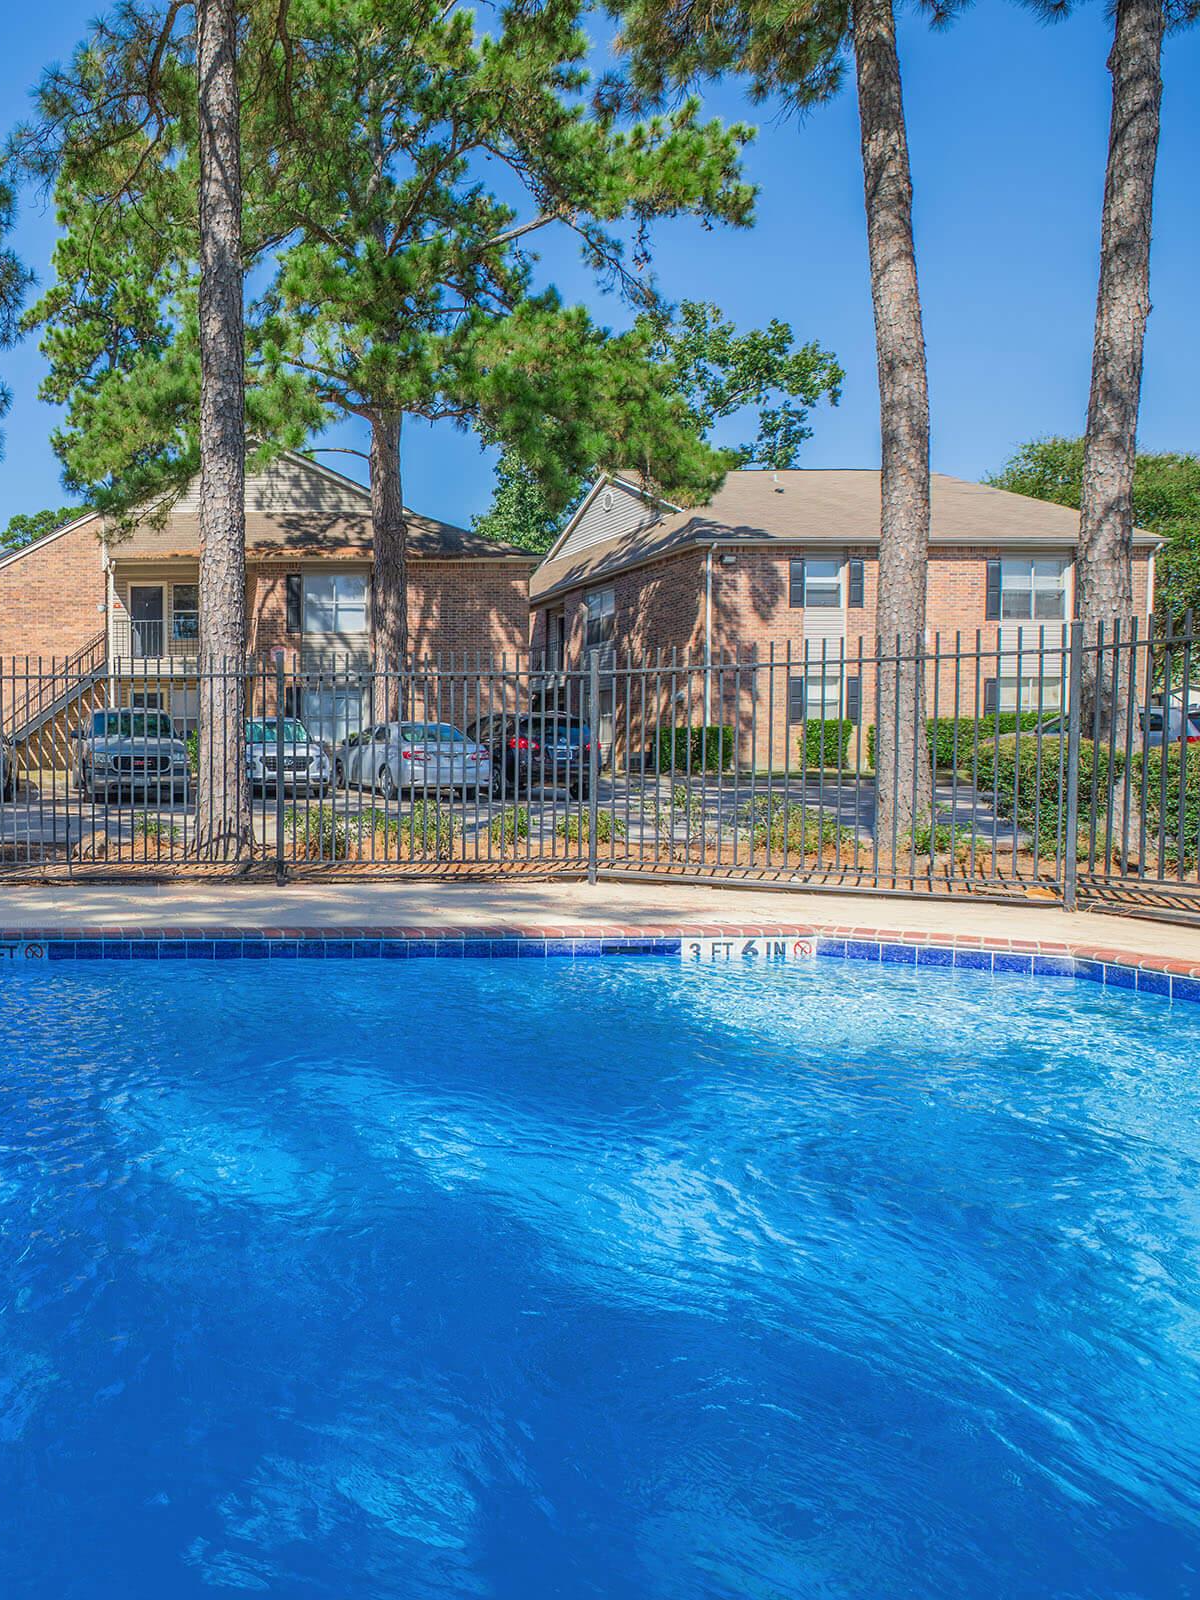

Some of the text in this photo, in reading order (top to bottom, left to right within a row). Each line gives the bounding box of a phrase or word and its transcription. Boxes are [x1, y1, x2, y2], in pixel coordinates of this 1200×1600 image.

[689, 940, 786, 961] 3 FT 6 IN
